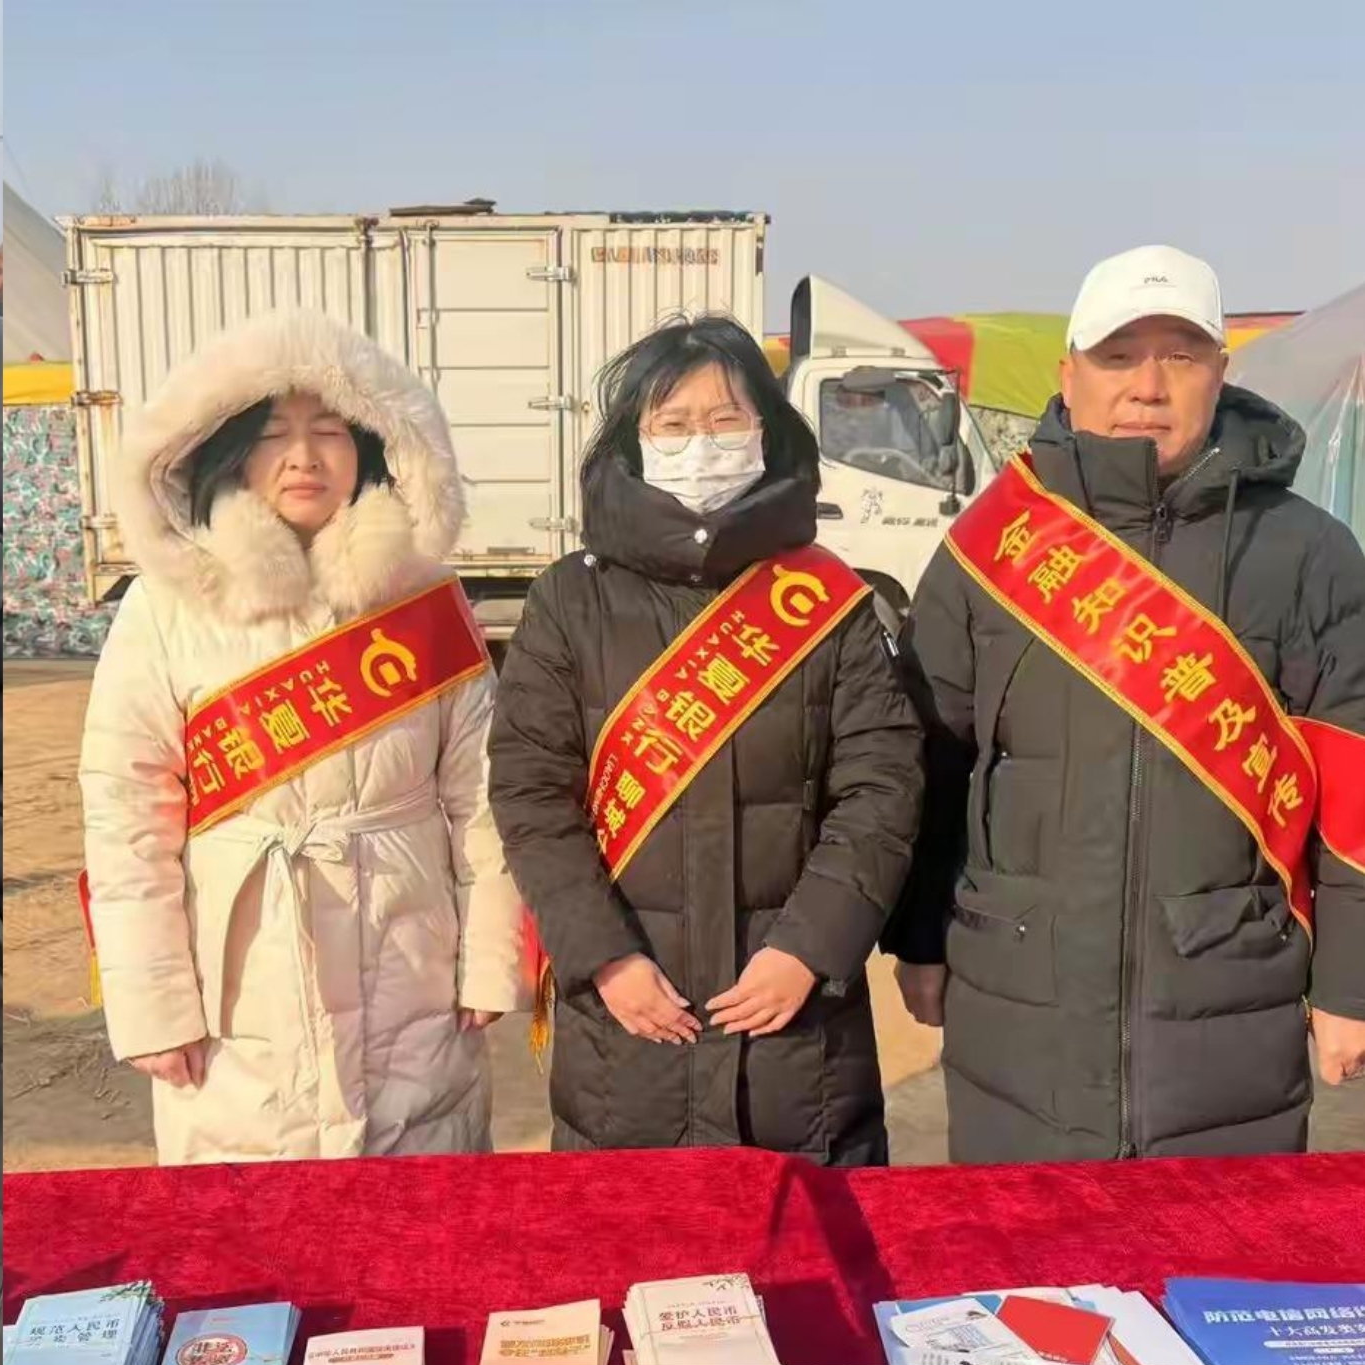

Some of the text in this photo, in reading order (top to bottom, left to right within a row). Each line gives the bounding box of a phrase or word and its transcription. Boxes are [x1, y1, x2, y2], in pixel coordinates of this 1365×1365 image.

[240, 660, 330, 716] HUAXIA
[621, 610, 745, 746] HUAXIA BANK
[991, 508, 1307, 827] 金融知识普及宣传
[193, 677, 353, 794] 华夏银行
